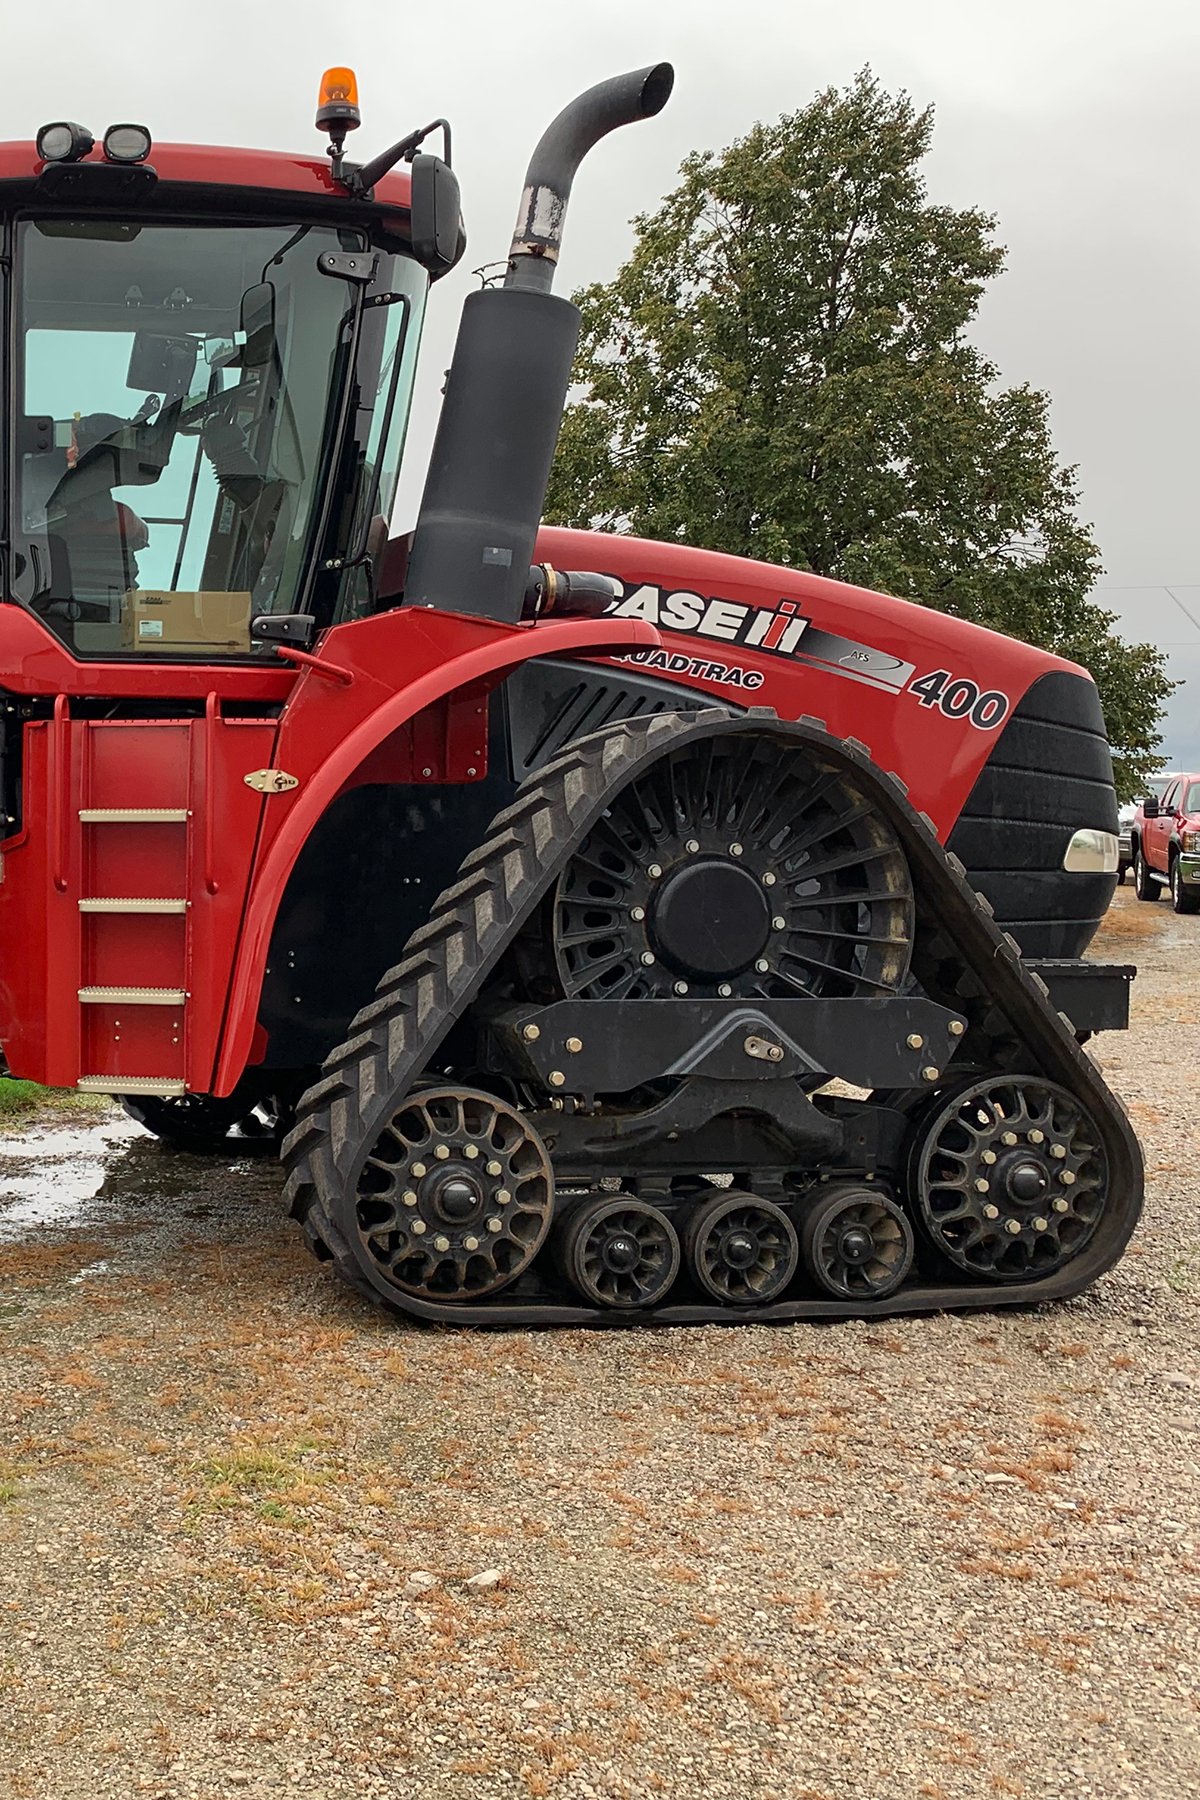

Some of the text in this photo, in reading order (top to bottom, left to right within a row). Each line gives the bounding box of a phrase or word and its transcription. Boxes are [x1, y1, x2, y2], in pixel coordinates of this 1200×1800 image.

[610, 649, 764, 690] UADTRAC
[850, 649, 870, 663] AFS
[907, 668, 1010, 731] 400
